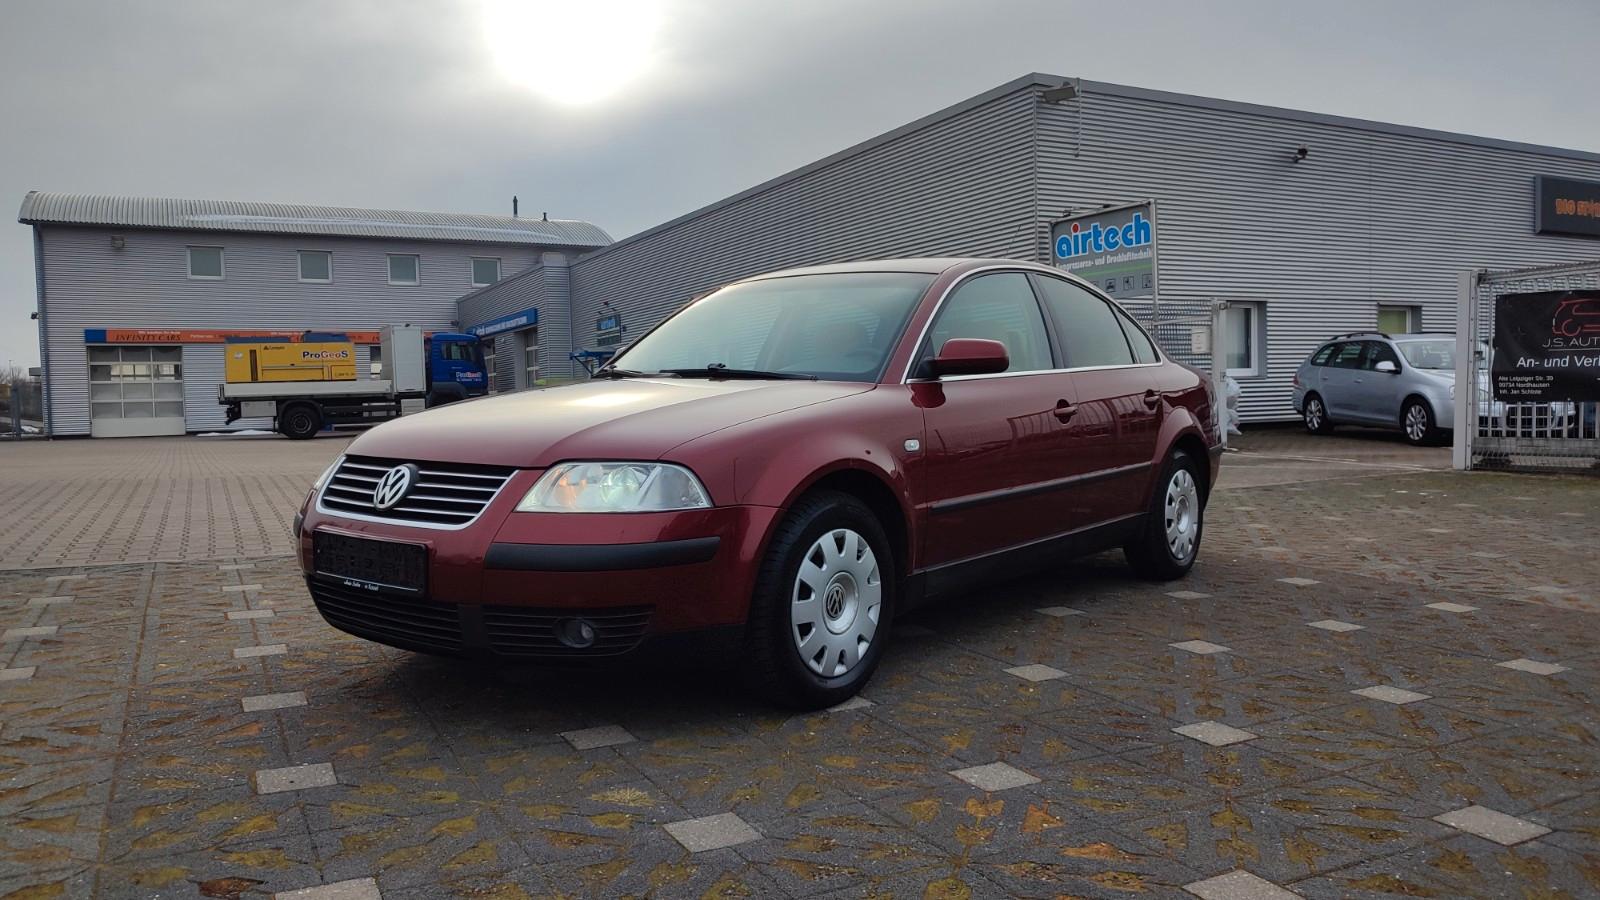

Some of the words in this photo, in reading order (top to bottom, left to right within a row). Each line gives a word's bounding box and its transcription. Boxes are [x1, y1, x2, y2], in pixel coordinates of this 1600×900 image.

[1056, 212, 1152, 259] airtech
[1095, 255, 1105, 266] und
[115, 333, 156, 341] INFINITY
[158, 333, 181, 341] CARS
[1542, 338, 1567, 348] J.S.
[302, 350, 349, 359] ProGeoS
[1516, 356, 1540, 368] An-
[1544, 355, 1569, 368] und
